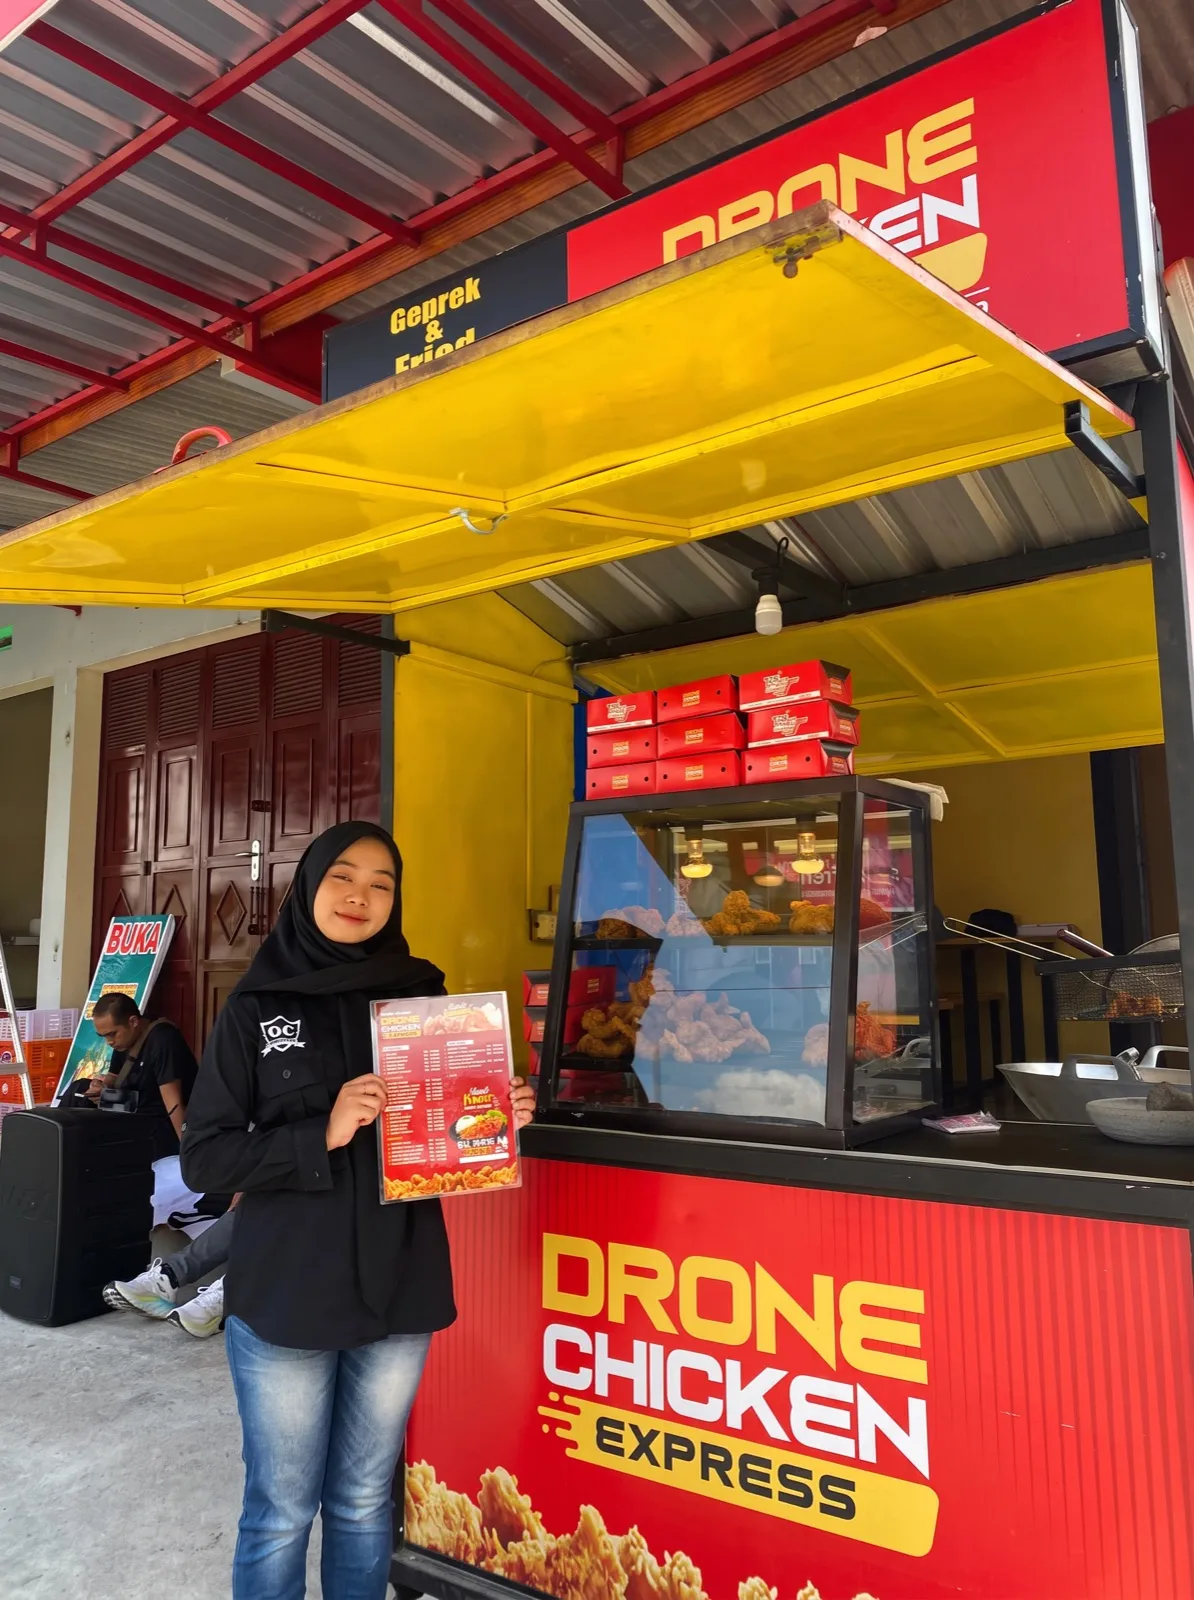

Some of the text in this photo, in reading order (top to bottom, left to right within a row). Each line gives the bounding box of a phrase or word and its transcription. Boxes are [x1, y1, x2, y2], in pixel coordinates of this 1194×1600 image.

[390, 277, 481, 334] Geprek
[425, 320, 443, 343] &
[105, 922, 162, 954] BUKA
[268, 1025, 295, 1038] OC
[542, 1232, 929, 1386] DRONE
[543, 1322, 930, 1480] CHICKEN
[595, 1416, 856, 1521] EXPRESS
